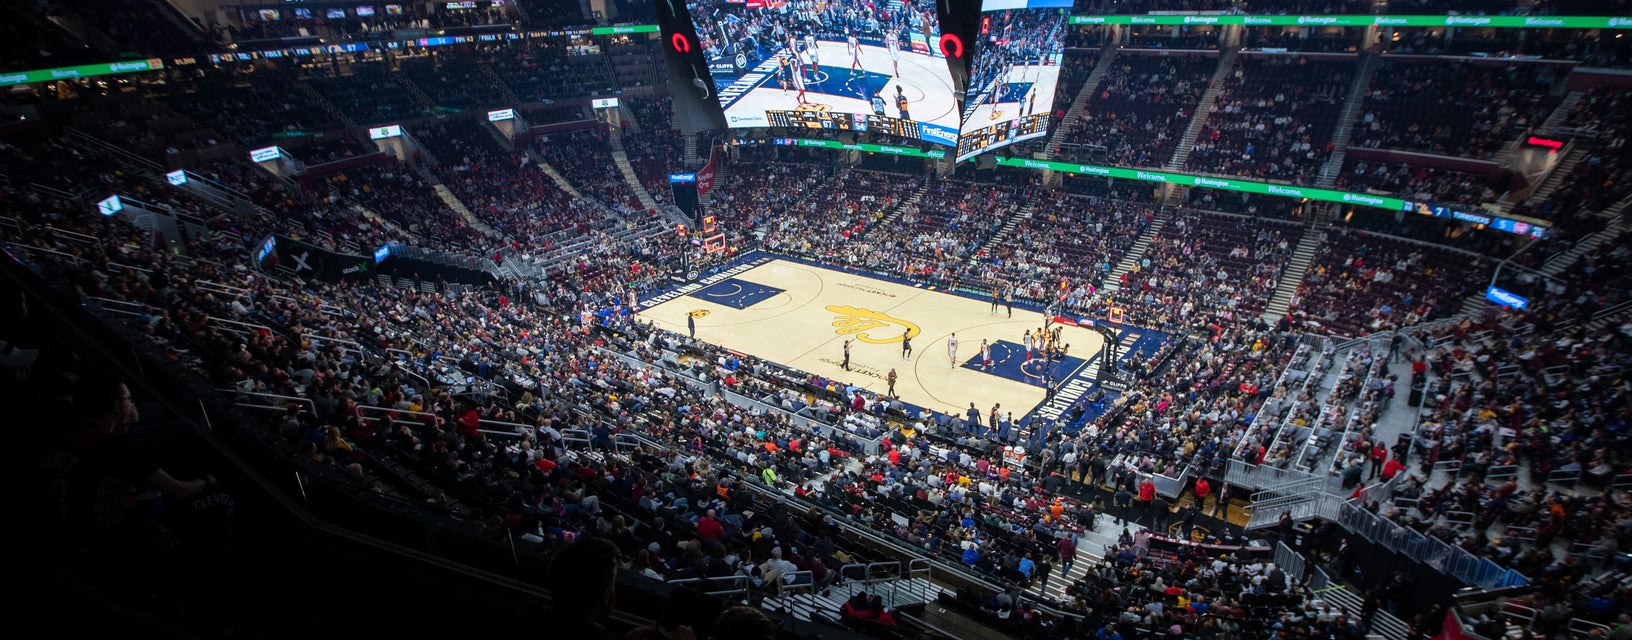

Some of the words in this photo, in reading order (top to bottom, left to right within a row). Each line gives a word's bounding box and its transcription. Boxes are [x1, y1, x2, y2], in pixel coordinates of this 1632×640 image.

[1024, 159, 1051, 169] Welcome.
[1085, 166, 1110, 174] Huntington
[1136, 171, 1167, 182] Welcome.
[1201, 179, 1229, 188] Huntington
[1267, 184, 1303, 196] Welcome.
[639, 283, 703, 308] CLEVELAND
[700, 263, 755, 285] CAVALIERS
[1109, 381, 1127, 389] CLIFFS
[1037, 379, 1093, 420] CAVALIERS
